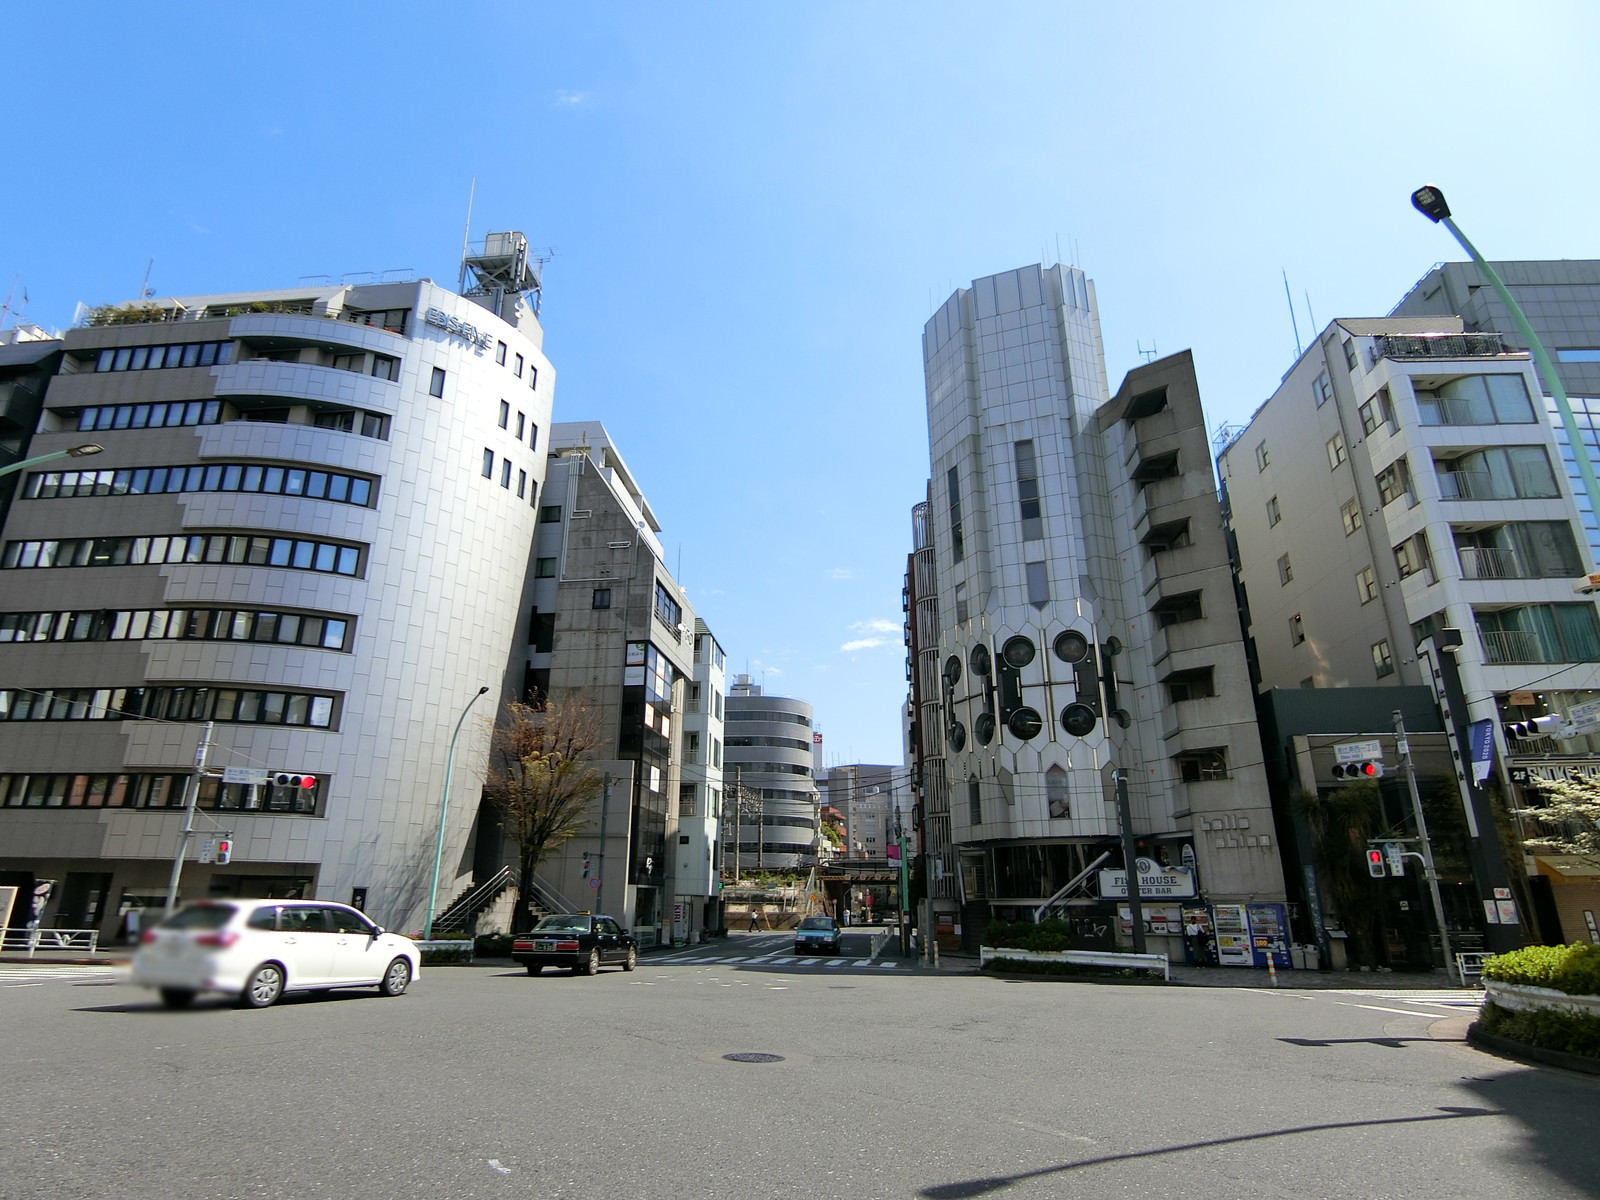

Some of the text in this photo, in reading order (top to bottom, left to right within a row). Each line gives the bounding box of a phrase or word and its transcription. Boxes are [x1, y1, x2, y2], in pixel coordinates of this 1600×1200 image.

[1481, 723, 1492, 760] TOKYO 2020
[1513, 771, 1526, 780] 2F
[1577, 765, 1600, 780] WO
[1141, 876, 1177, 885] HOUSE
[1155, 887, 1172, 895] BAR
